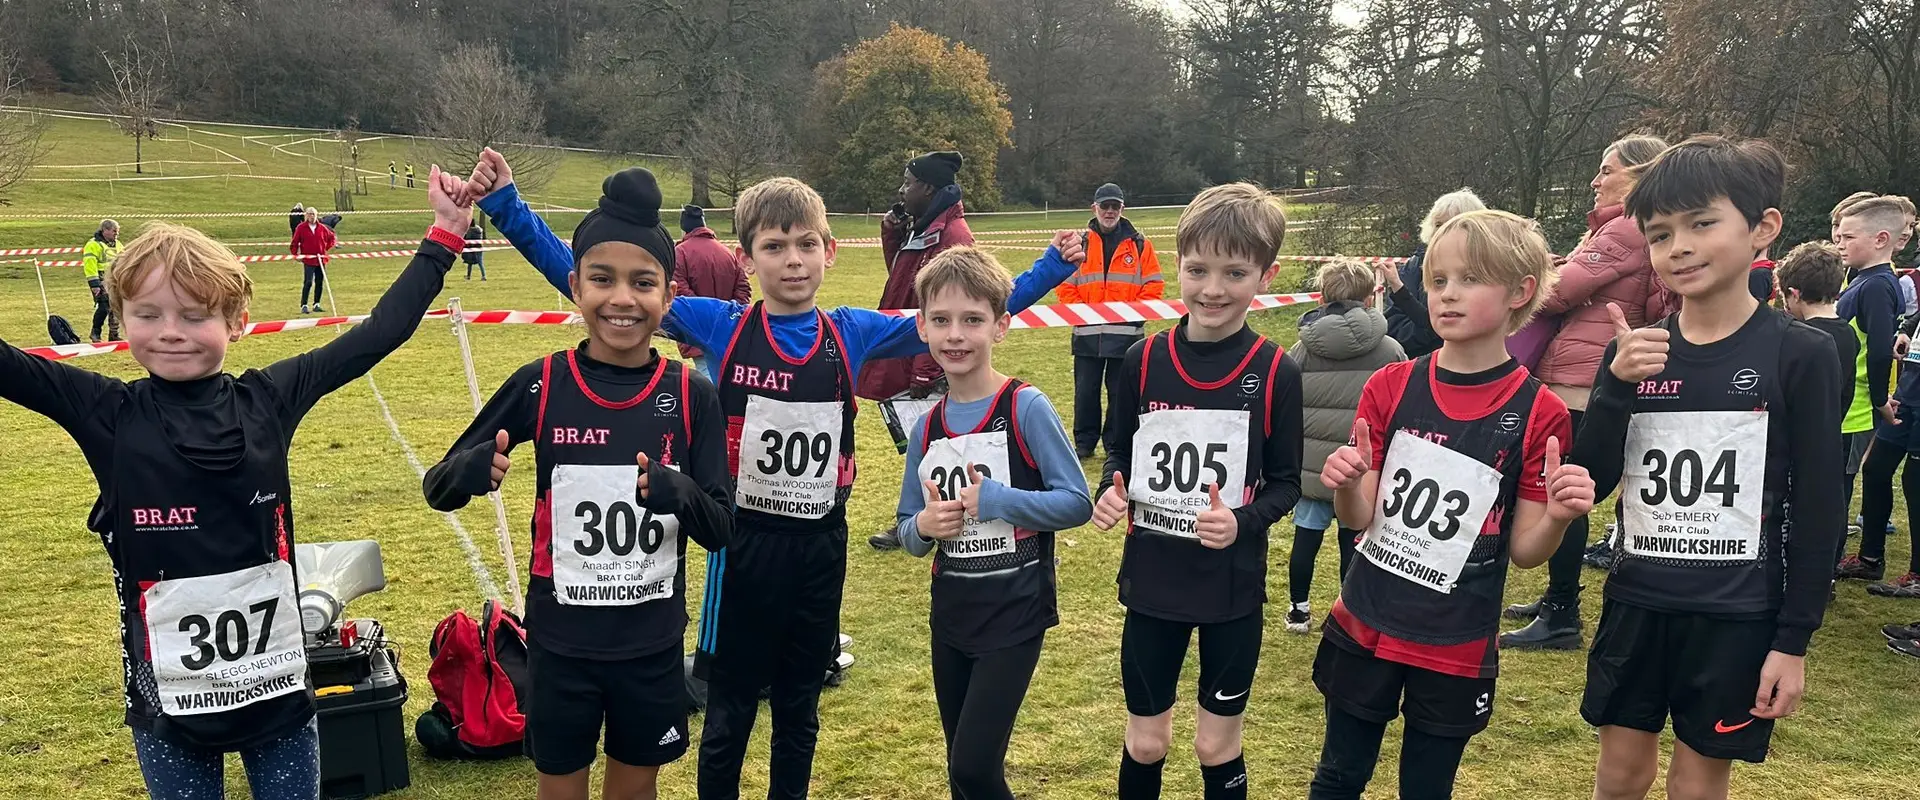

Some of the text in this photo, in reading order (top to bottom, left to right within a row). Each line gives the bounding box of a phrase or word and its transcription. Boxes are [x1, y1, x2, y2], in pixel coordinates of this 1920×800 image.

[732, 364, 794, 391] BRAT
[1637, 380, 1682, 394] BRAT
[552, 428, 610, 444] BRAT
[757, 429, 832, 478] 309
[1148, 441, 1228, 493] 305
[747, 474, 780, 487] Thomas
[1640, 449, 1740, 507] 304
[745, 494, 830, 515] WARWICKSHIRE
[772, 489, 812, 499] BRAT Club
[1148, 495, 1178, 505] Charlie
[1382, 467, 1470, 541] 303
[133, 507, 197, 524] BRAT
[1652, 511, 1720, 522] Seb EMERY
[573, 500, 664, 556] 306
[1382, 523, 1432, 549] Alex BONE
[1658, 525, 1710, 535] BRAT Club
[1380, 536, 1421, 558] BRAT Club
[1633, 535, 1747, 555] WARWICKSHIRE
[582, 559, 656, 570] Anaadh SINGH
[1362, 538, 1448, 587] WARWICKSHIRE
[597, 573, 643, 582] BRAT Club
[566, 579, 665, 601] WARWICKSHIRE
[178, 597, 280, 671] 307
[205, 649, 302, 681] SLEGG-NEWTON
[175, 673, 297, 710] WARWICKSHIRE
[212, 674, 265, 689] BRAT Club
[659, 734, 680, 745] adidas
